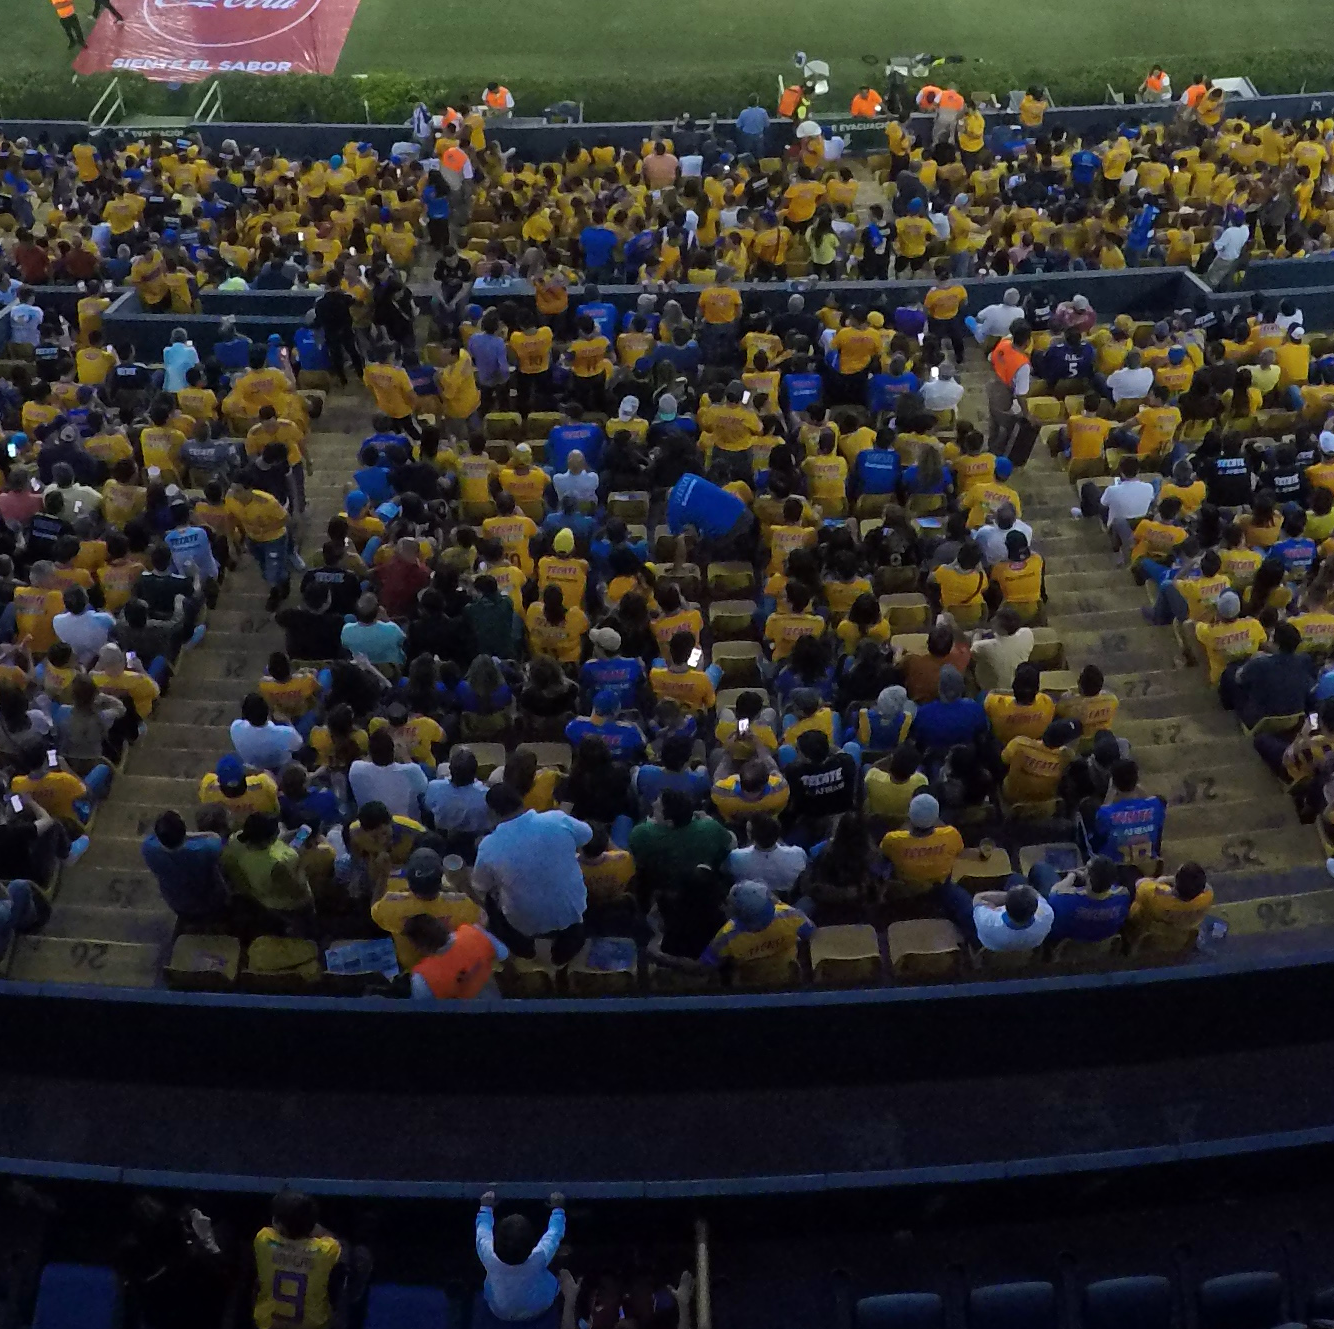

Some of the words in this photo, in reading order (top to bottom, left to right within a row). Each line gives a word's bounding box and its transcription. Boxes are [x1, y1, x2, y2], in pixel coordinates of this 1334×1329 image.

[111, 58, 183, 69] SIENTE
[187, 59, 213, 70] EL
[219, 60, 292, 72] SABOR
[1068, 363, 1078, 378] 5
[271, 1271, 308, 1323] 9
